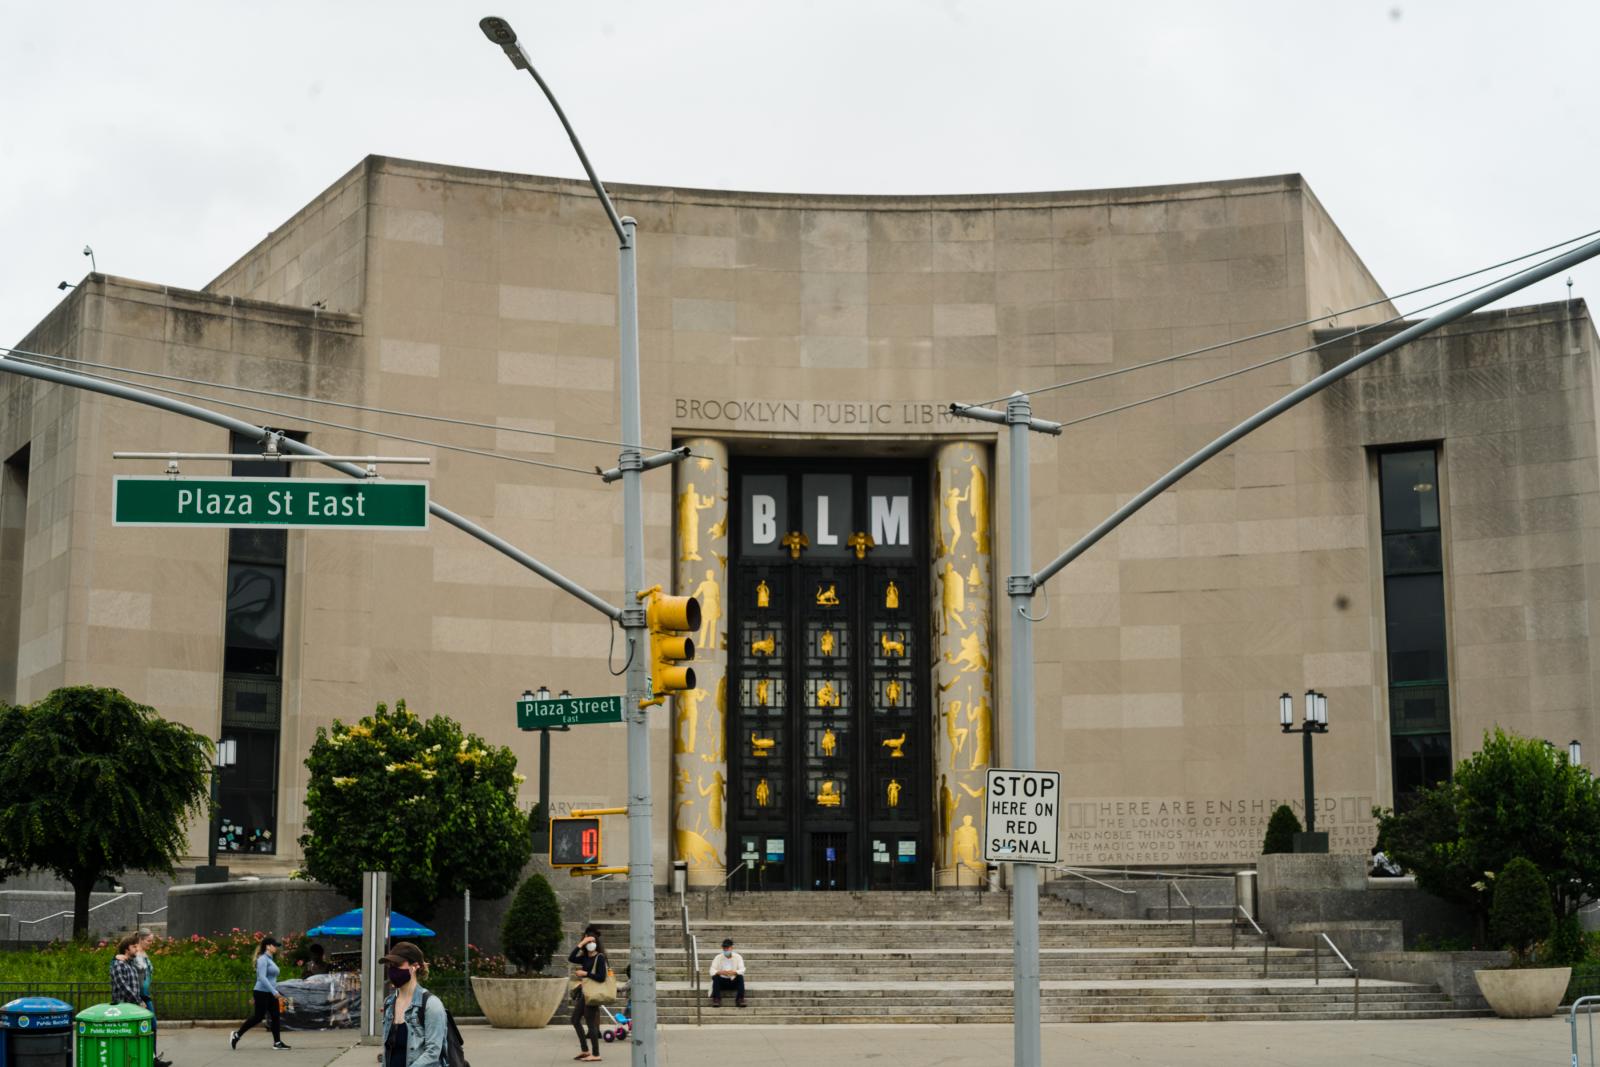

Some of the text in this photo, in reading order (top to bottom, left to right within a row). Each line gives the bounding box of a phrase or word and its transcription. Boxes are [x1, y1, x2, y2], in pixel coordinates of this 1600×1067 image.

[675, 399, 799, 422] BROOKLYN
[813, 404, 892, 424] PUBLIC
[177, 488, 365, 517] Plaza St East
[752, 494, 909, 545] B L M
[525, 699, 615, 717] Plaza Street
[563, 715, 578, 723] East
[992, 776, 1054, 797] STOP
[992, 801, 1053, 816] HERE ON
[1101, 802, 1150, 816] HERE
[1159, 801, 1195, 815] ARE
[1006, 820, 1037, 834] RED
[1101, 818, 1125, 828] THE
[1132, 817, 1197, 828] LONGING
[1203, 816, 1221, 827] OF
[1068, 831, 1091, 841] AND
[1095, 831, 1132, 840] NOBLE
[1137, 830, 1182, 840] THINGS
[1188, 829, 1216, 839] THAT
[1220, 828, 1263, 839] TOWER
[1343, 826, 1374, 836] TIDE
[992, 839, 1052, 854] SIGNAL
[1068, 842, 1089, 852] THE
[1093, 842, 1134, 852] MAGIC
[1180, 840, 1209, 850] THAT
[1214, 839, 1264, 849] WINGED
[1330, 837, 1374, 847] STARTS
[1068, 853, 1092, 862] THE
